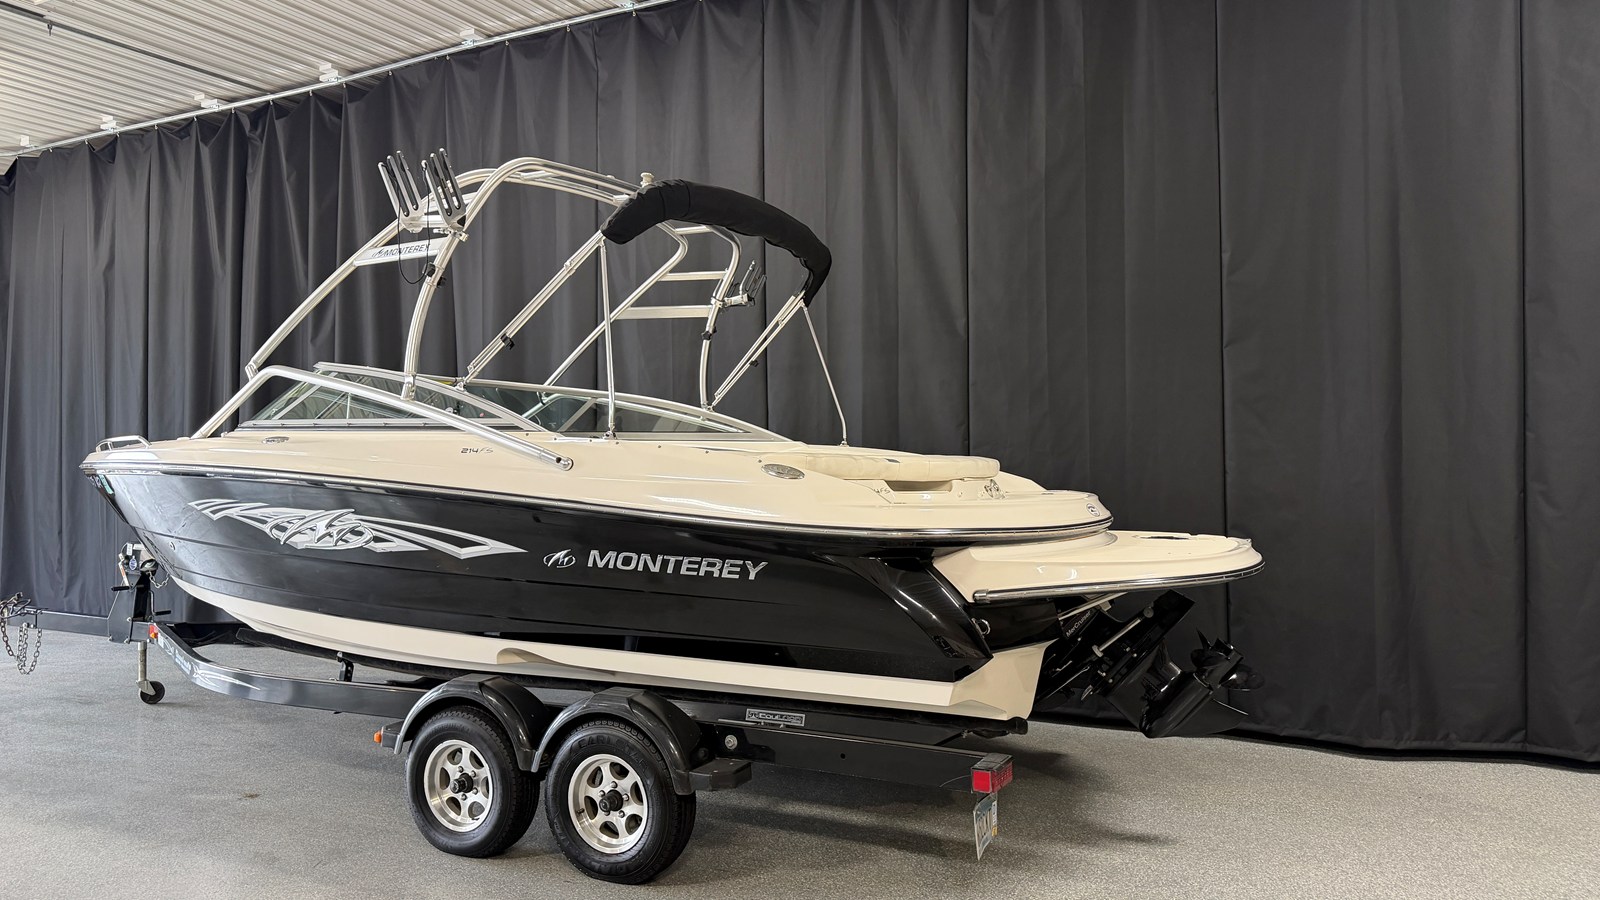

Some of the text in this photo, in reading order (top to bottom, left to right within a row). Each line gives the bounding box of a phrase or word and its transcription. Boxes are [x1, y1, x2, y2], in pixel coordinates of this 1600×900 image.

[383, 244, 431, 257] MONTEREY
[587, 549, 768, 581] MONTEREY
[1065, 610, 1091, 638] MerCruiser
